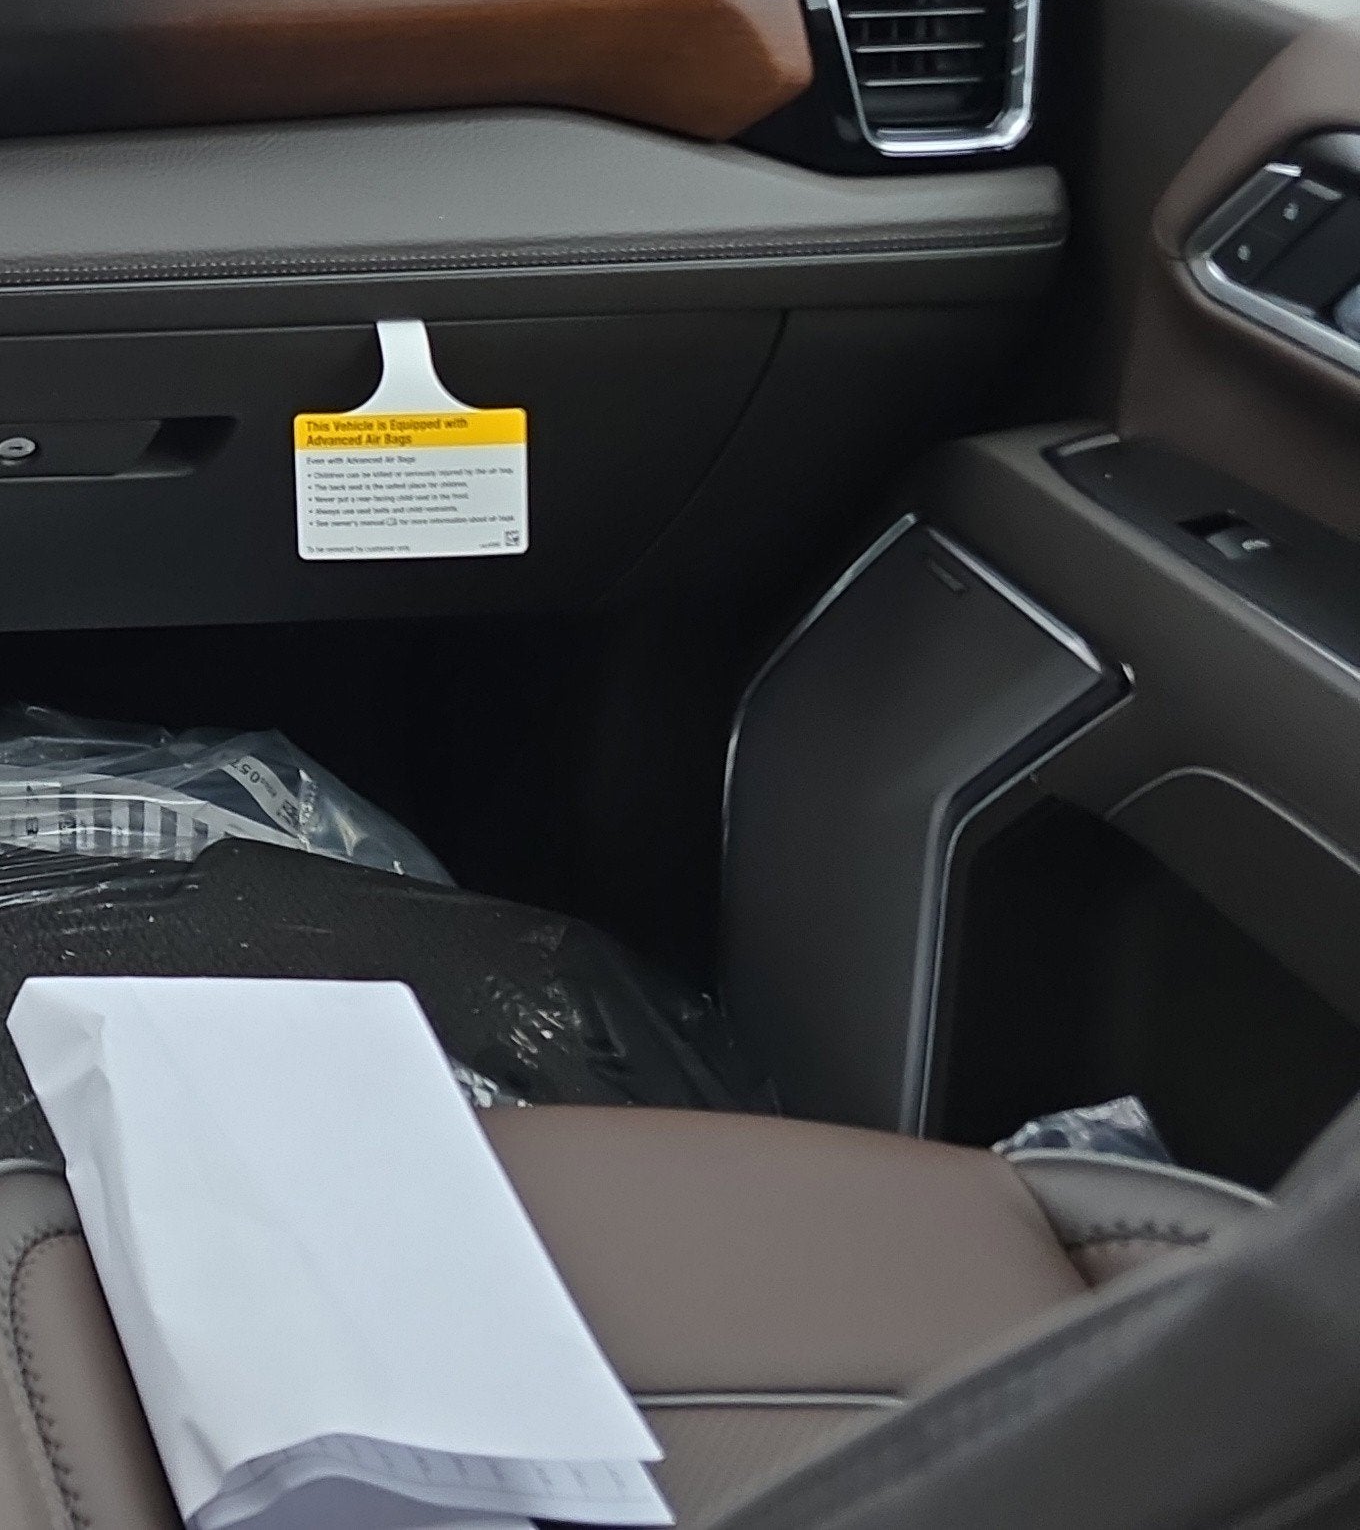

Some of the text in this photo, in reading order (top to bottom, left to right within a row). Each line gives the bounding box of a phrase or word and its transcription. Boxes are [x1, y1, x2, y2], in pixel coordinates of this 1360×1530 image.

[306, 417, 469, 433] This Vehicle is Equipped with
[306, 433, 413, 447] Advanced Air Bags
